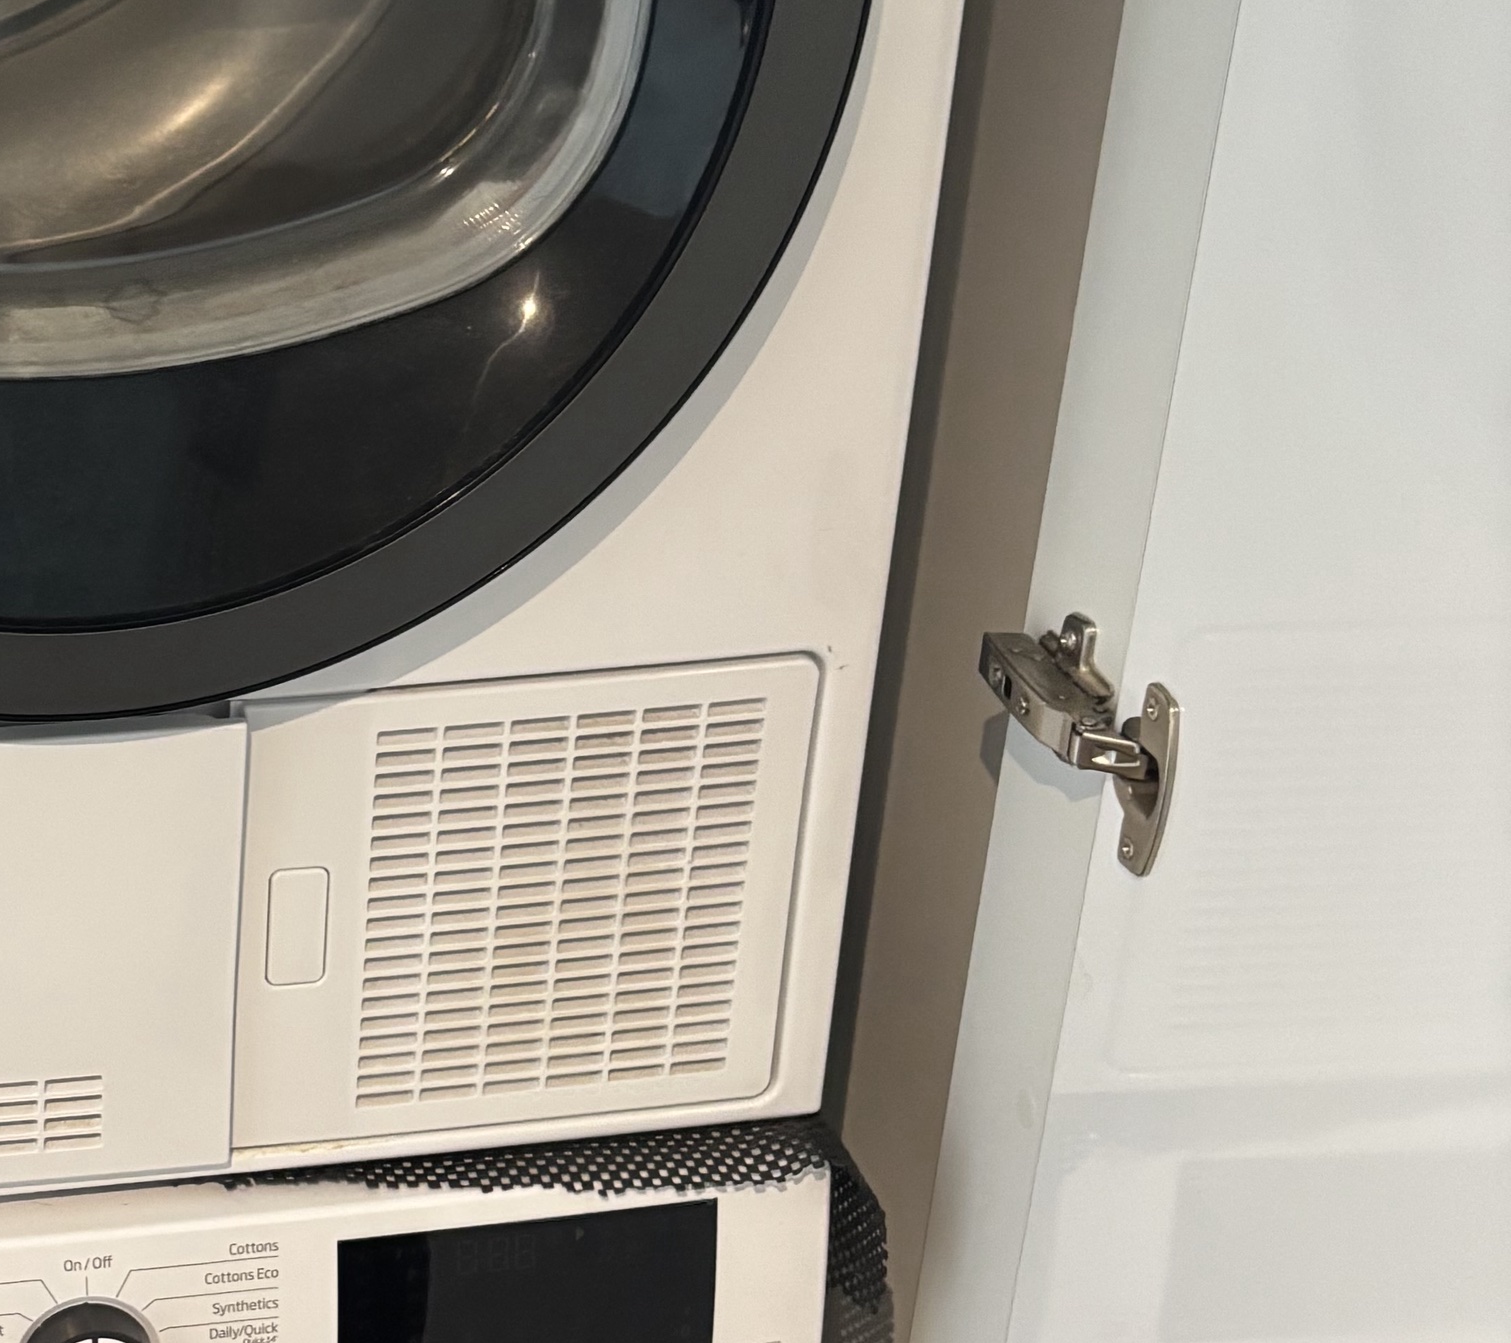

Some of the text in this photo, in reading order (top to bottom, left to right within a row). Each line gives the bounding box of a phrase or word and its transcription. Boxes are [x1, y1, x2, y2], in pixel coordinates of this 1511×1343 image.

[229, 1241, 279, 1256] Cottons
[63, 1260, 82, 1272] On
[92, 1255, 113, 1269] Off
[204, 1267, 279, 1285] Cottons Eco
[212, 1297, 279, 1316] Synthetics
[209, 1322, 278, 1340] Daily/Quick
